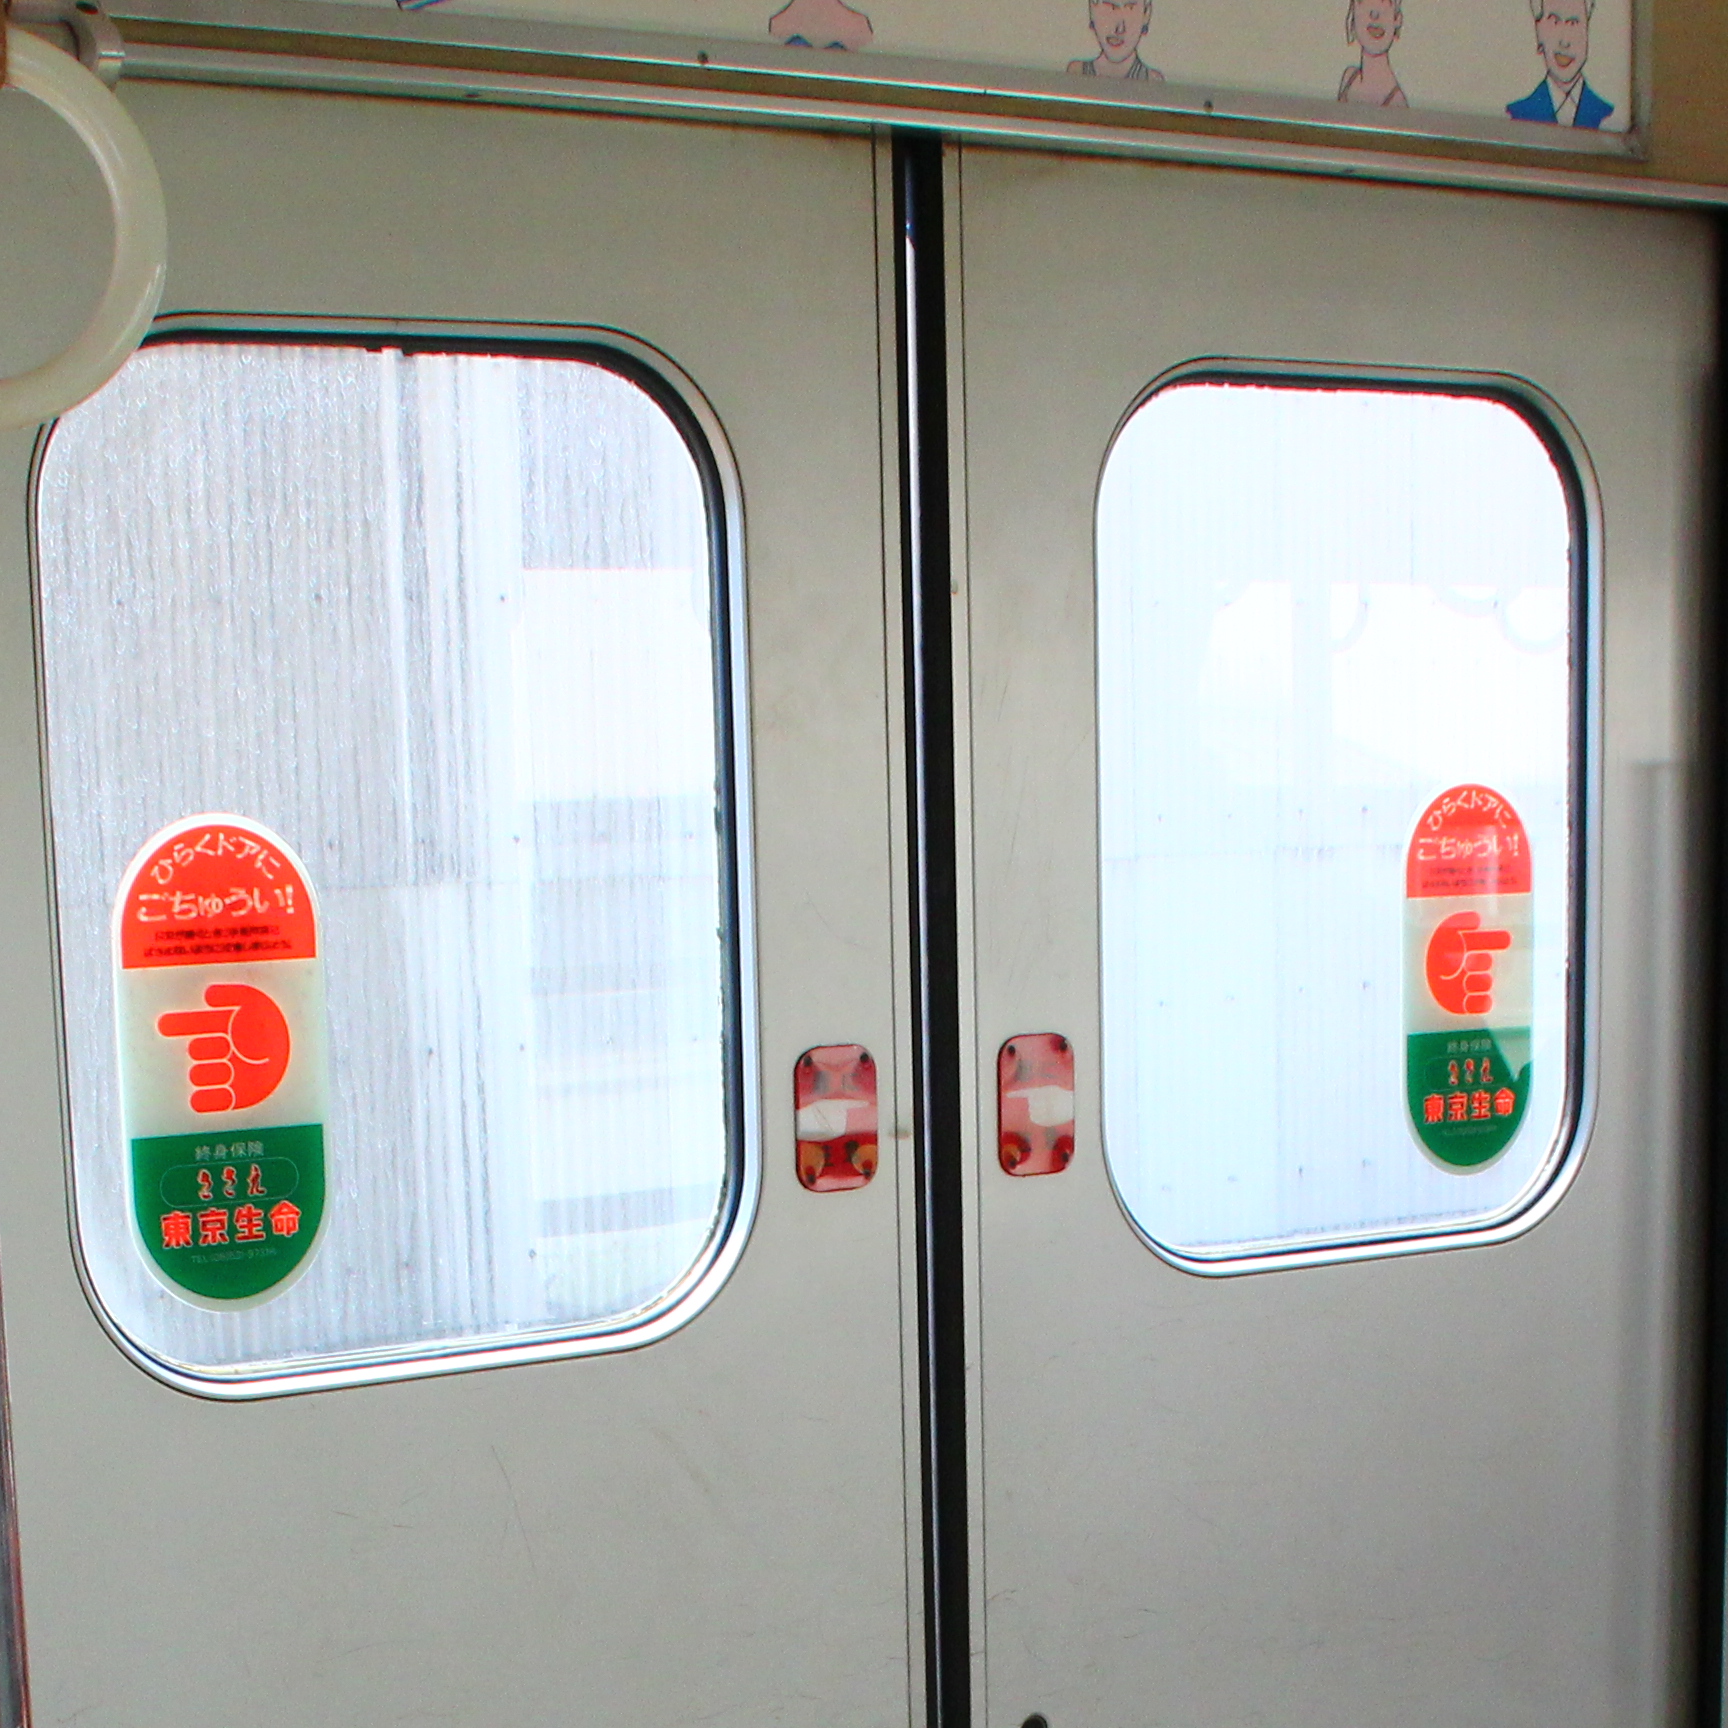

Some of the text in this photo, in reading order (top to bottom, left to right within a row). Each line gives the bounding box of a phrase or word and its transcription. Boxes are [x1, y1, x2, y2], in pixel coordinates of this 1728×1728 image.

[1427, 790, 1513, 831] ひらくドアに
[150, 831, 282, 885] ひらくドアに
[136, 884, 296, 922] ごちゅうい!
[1424, 1087, 1516, 1123] 東京生命
[160, 1200, 302, 1249] 東京生命
